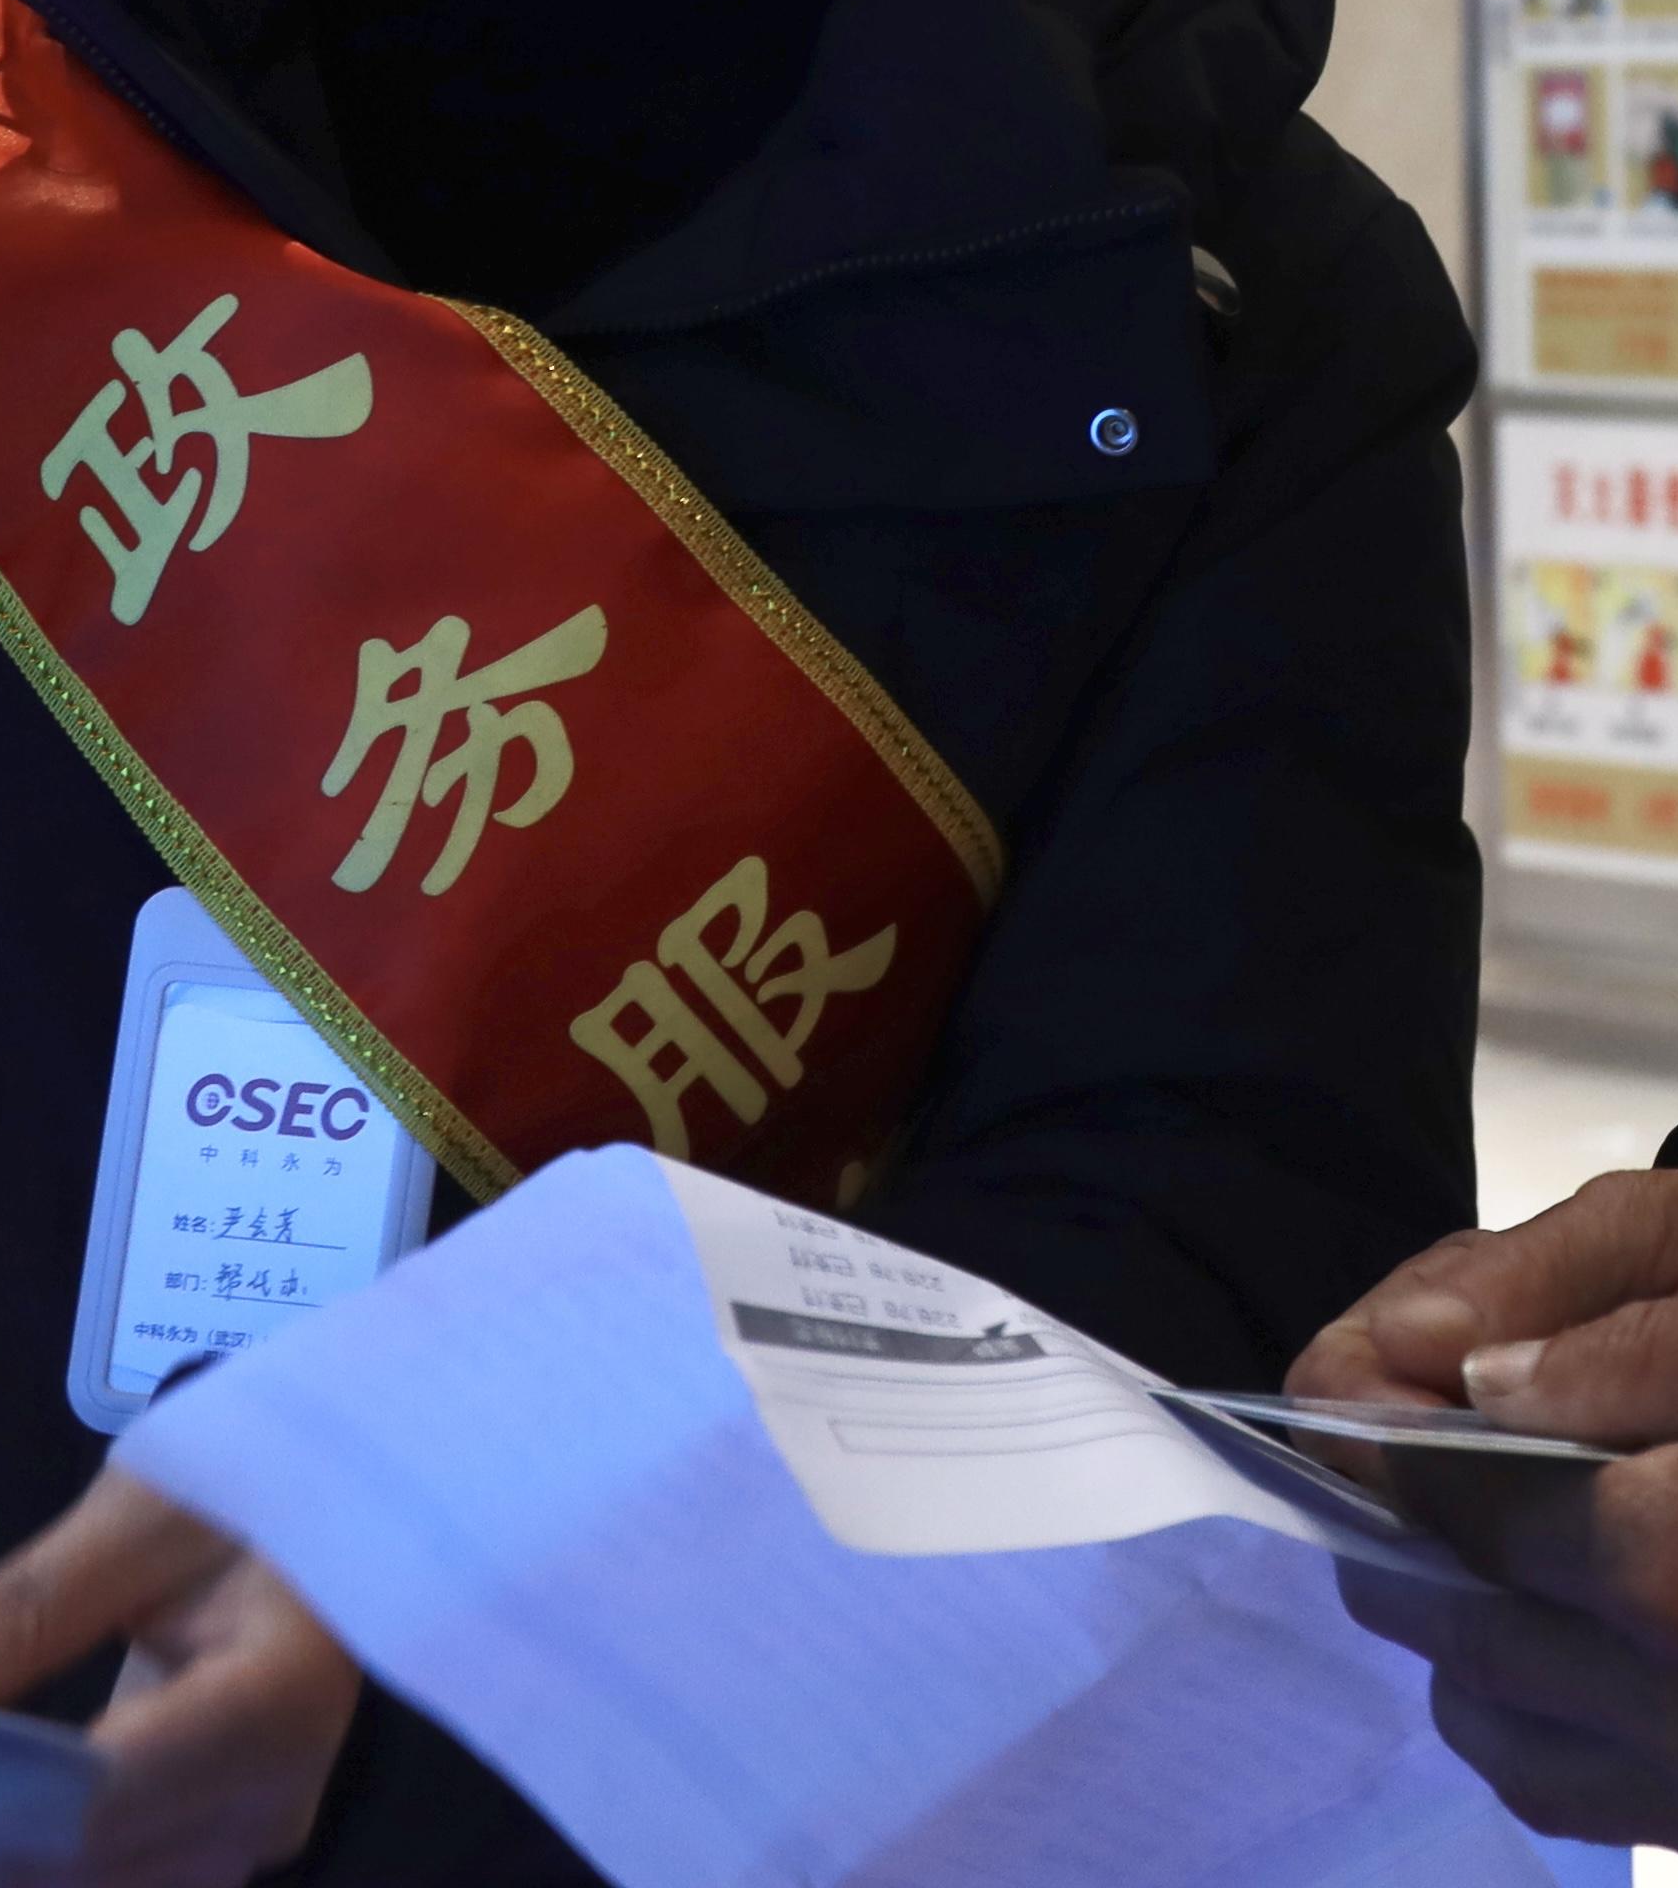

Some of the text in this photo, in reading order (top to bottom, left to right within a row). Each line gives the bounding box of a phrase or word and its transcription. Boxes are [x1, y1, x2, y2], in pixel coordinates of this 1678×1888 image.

[39, 293, 898, 1206] 政务服
[186, 1073, 370, 1141] CSEC
[199, 1144, 343, 1177] 中科永为
[133, 1321, 268, 1349] 中科永为（武汉）
